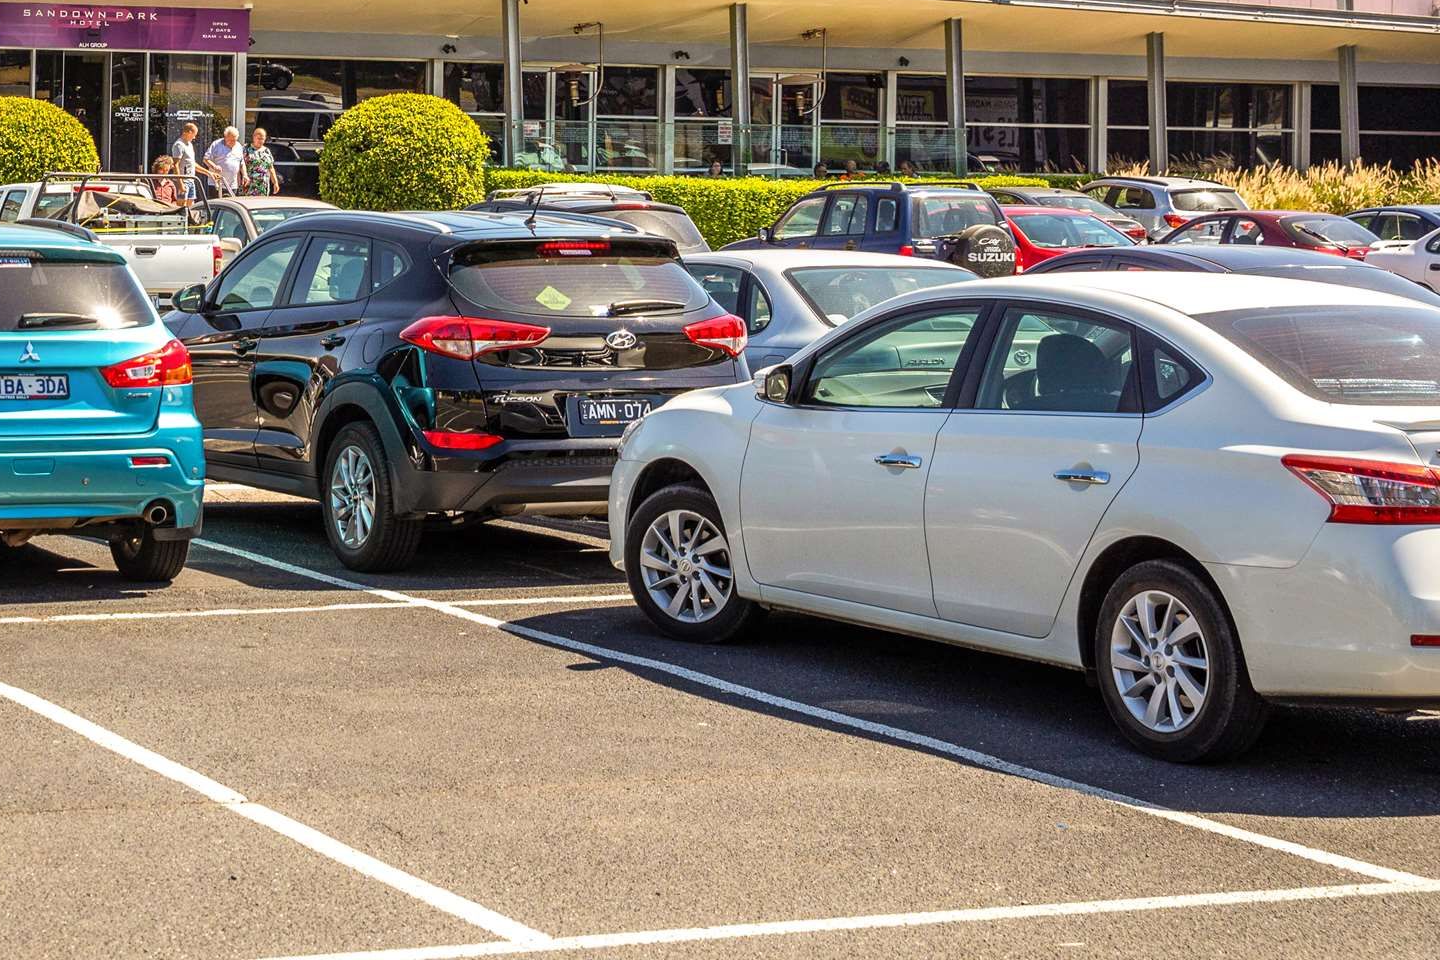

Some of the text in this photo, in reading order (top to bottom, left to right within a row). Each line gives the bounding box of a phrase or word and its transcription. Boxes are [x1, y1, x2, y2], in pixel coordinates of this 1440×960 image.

[23, 9, 158, 21] SANDOWN PARK
[978, 237, 1000, 246] City
[967, 252, 1015, 262] SUZUKI
[492, 394, 543, 403] TUCSON
